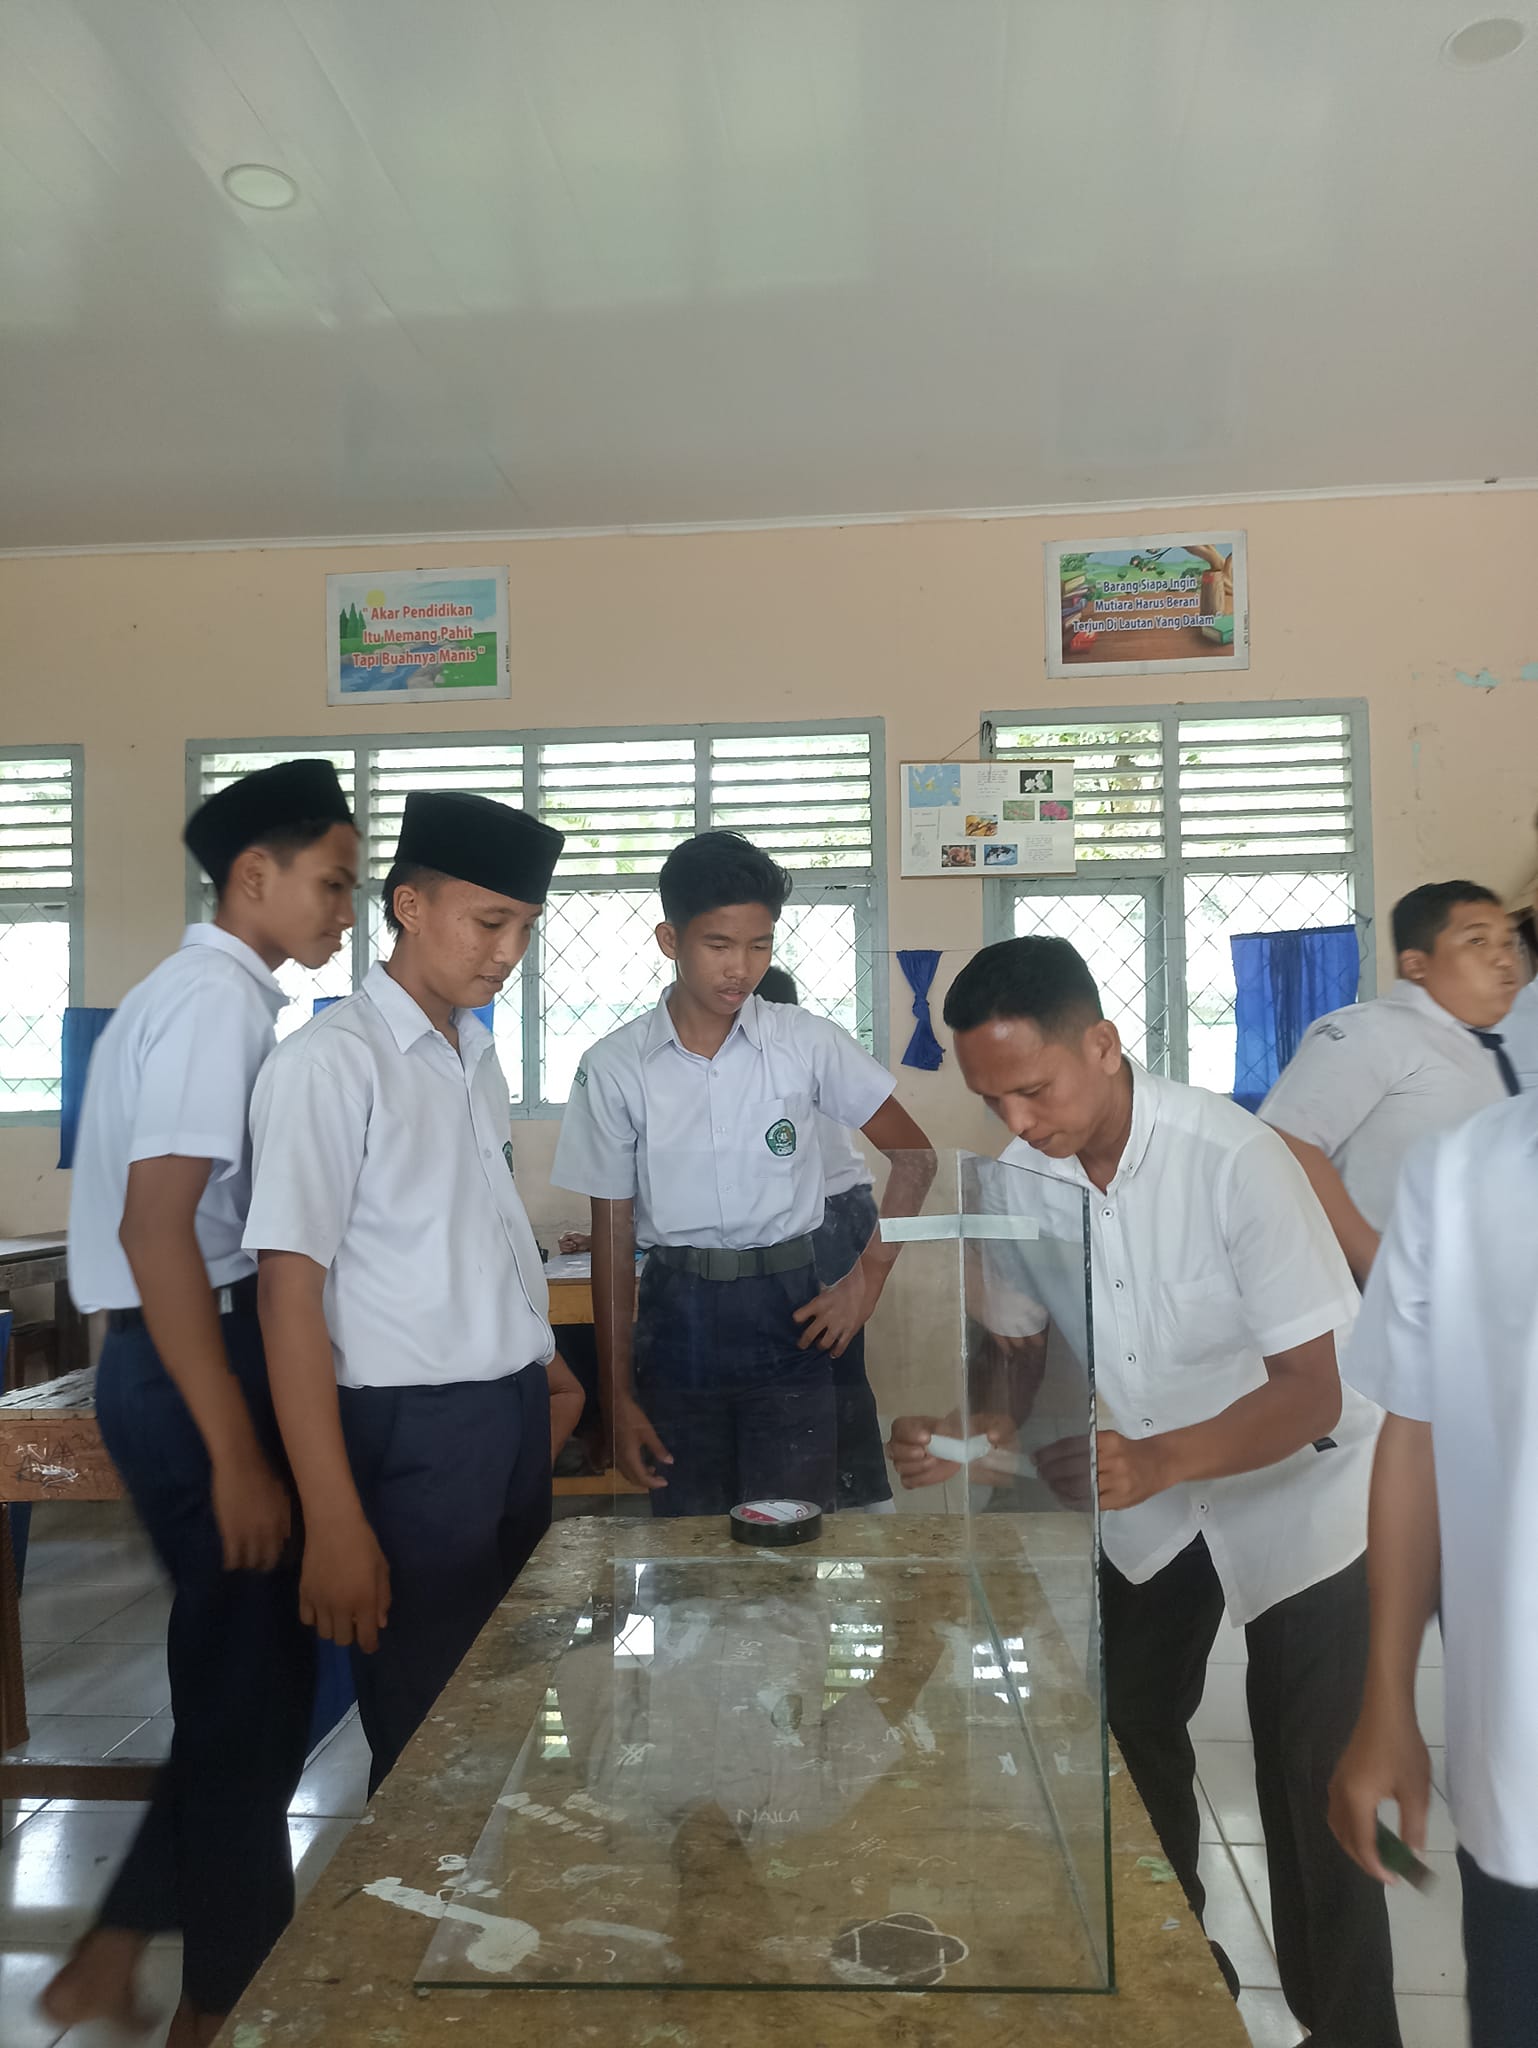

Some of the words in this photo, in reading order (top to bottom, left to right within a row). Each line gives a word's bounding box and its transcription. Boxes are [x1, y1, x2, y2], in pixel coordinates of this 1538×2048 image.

[1103, 580, 1139, 593] Barang
[1141, 579, 1168, 591] Siapa
[1170, 576, 1196, 590] Ingin
[1095, 600, 1133, 611] Mutiara
[1135, 599, 1164, 610] Harus
[1166, 595, 1199, 608] Berani
[371, 606, 400, 620] Akar
[402, 604, 473, 618] Pendidikan
[1073, 619, 1104, 632] Terjun
[1106, 618, 1118, 631] Di
[1119, 617, 1153, 629] Lautan
[1155, 616, 1181, 630] Yang
[363, 631, 381, 643] Itu
[383, 628, 438, 644] Memang
[440, 626, 473, 639] Pahit
[353, 652, 379, 669] Tapi
[382, 649, 436, 666] Buahnya
